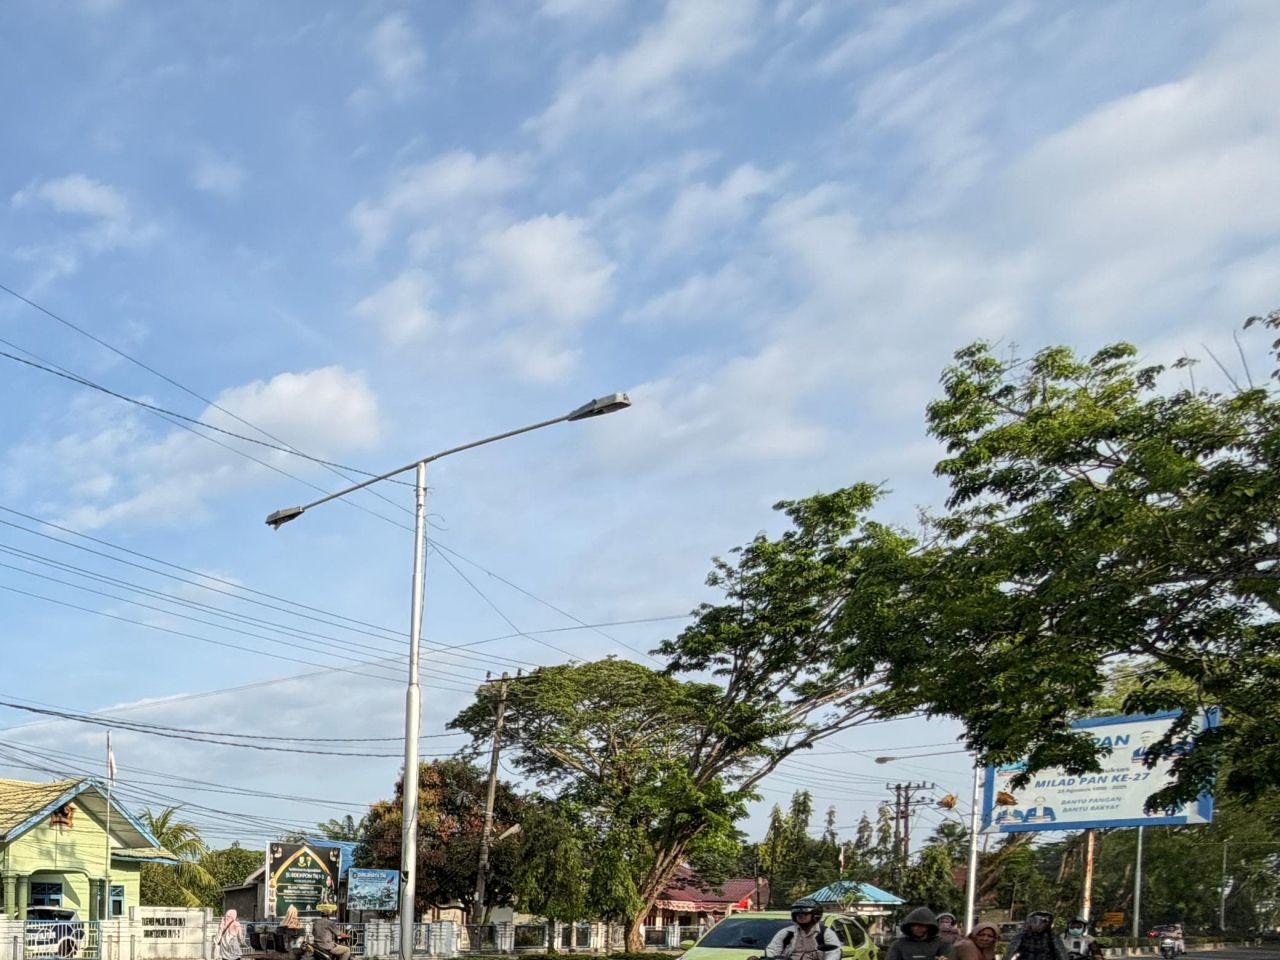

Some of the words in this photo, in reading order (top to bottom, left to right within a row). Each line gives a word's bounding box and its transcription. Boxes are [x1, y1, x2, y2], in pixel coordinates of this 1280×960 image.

[1034, 778, 1077, 788] MILAD
[1079, 775, 1109, 786] PAN
[1111, 772, 1151, 783] KE-27
[1088, 796, 1122, 804] PANGAN
[1090, 804, 1121, 812] RAKYAT
